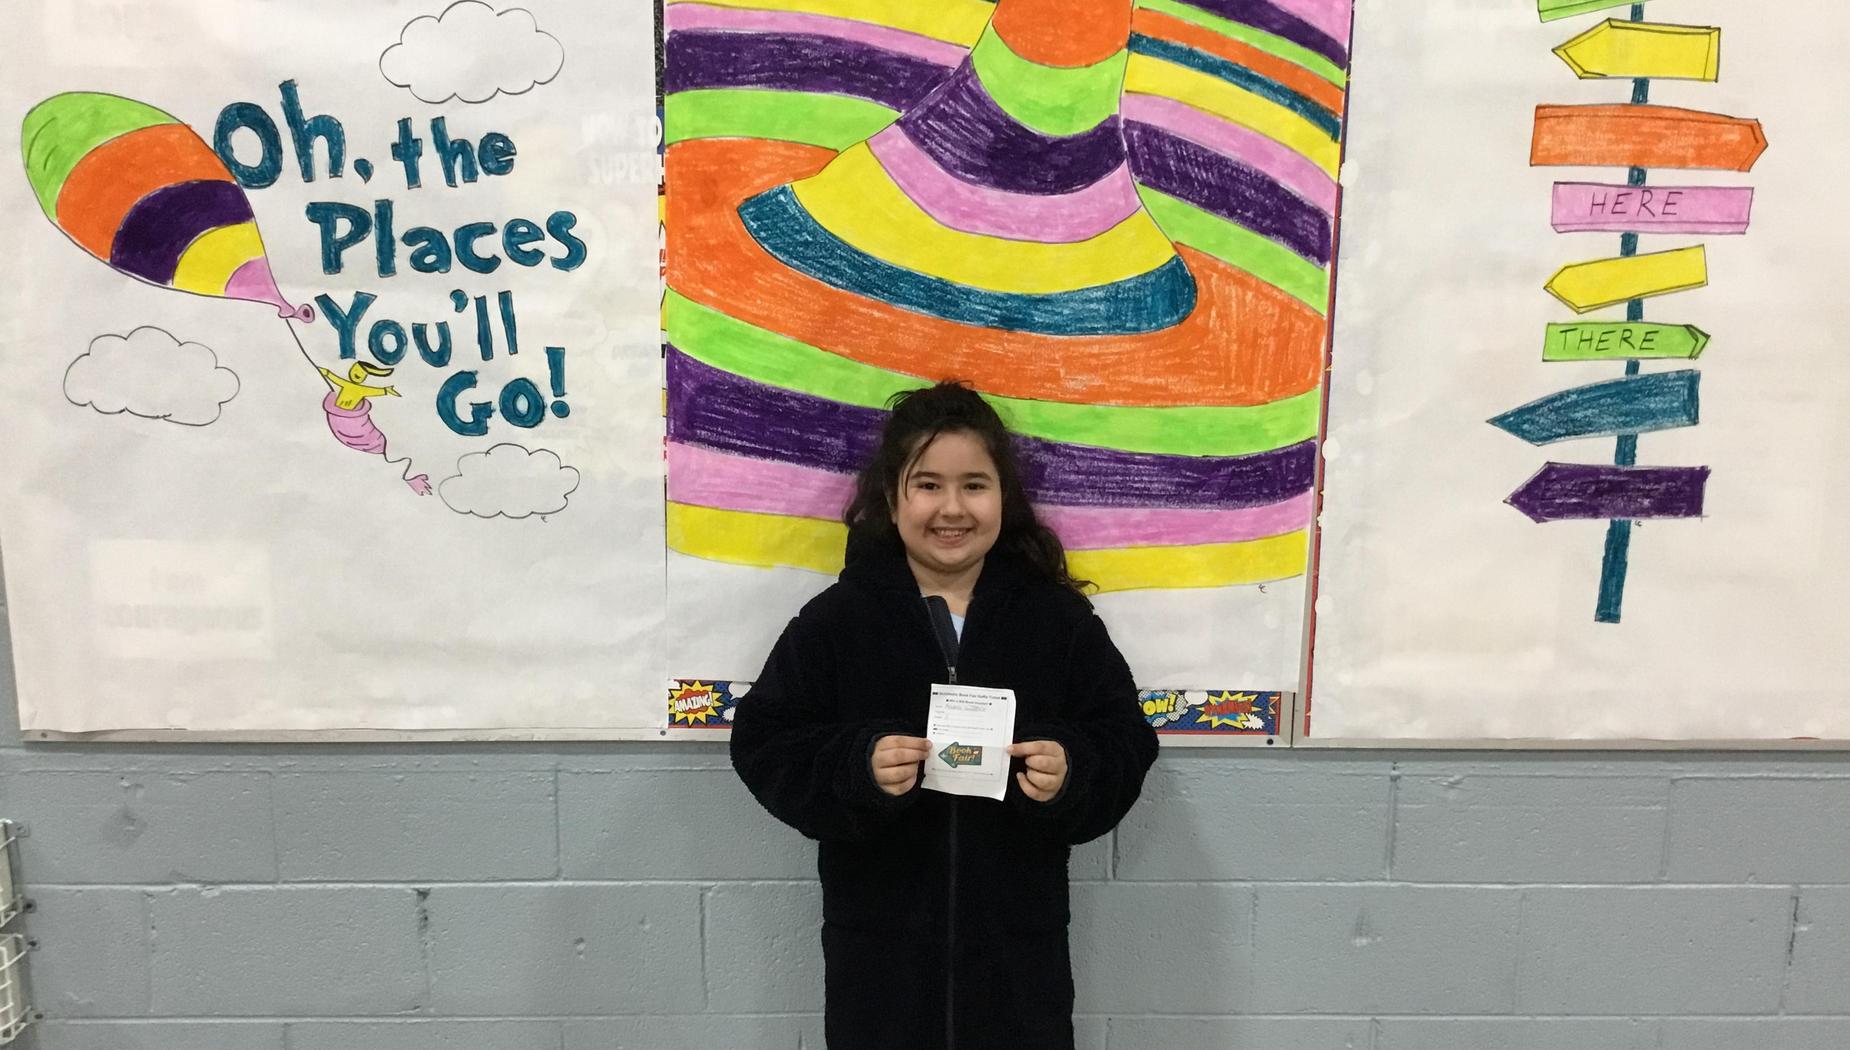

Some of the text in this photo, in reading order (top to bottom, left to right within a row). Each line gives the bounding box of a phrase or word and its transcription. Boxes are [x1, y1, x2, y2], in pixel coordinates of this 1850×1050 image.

[213, 79, 517, 189] Oh, the
[1589, 190, 1684, 217] HERE
[306, 199, 587, 278] Places
[315, 289, 518, 367] You'll
[1559, 328, 1660, 353] THERE
[436, 347, 571, 437] Go!
[674, 691, 713, 713] AMAZING!
[1138, 692, 1177, 716] OW!
[949, 746, 972, 754] Book
[953, 753, 976, 762] Fair!
